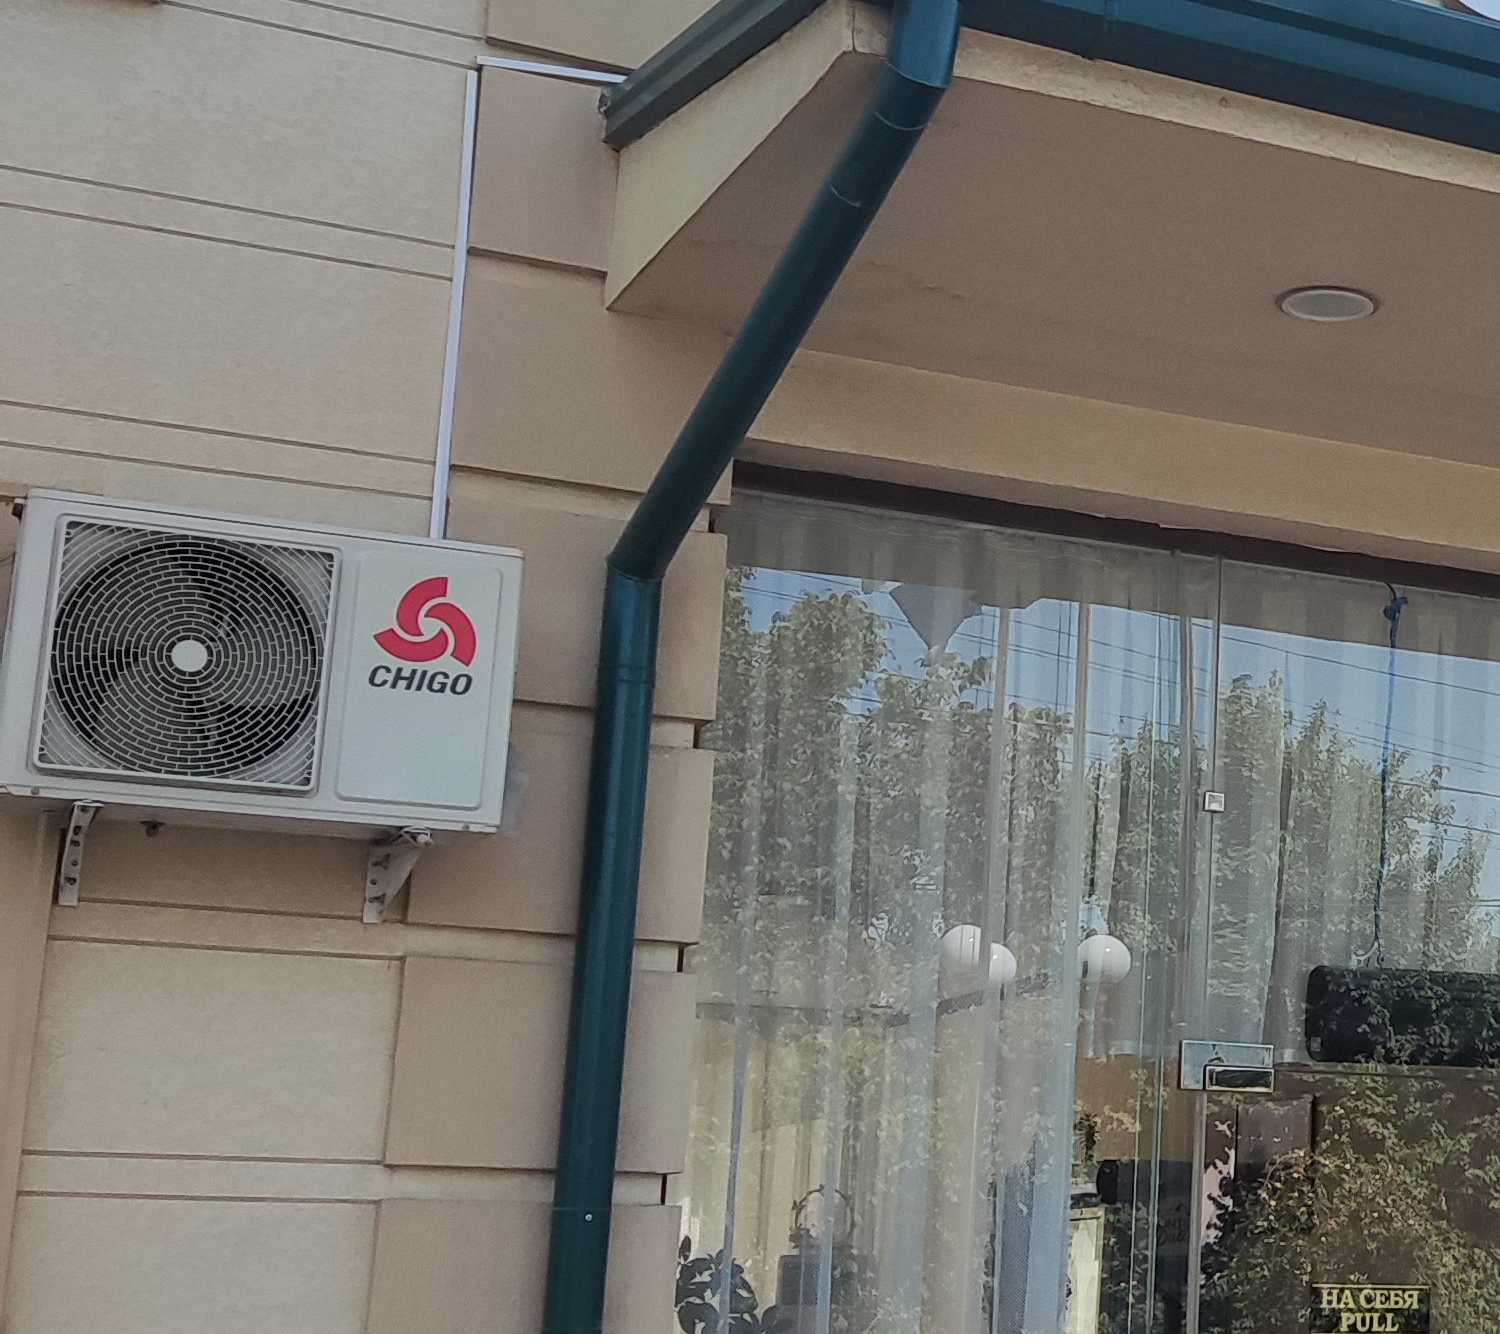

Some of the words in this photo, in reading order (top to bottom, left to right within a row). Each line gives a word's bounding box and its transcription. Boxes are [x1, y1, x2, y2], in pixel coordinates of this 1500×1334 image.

[368, 665, 473, 695] CHIGO
[1321, 1288, 1355, 1309] НА
[1360, 1288, 1420, 1309] СЕБЯ
[1340, 1312, 1399, 1332] PULL
